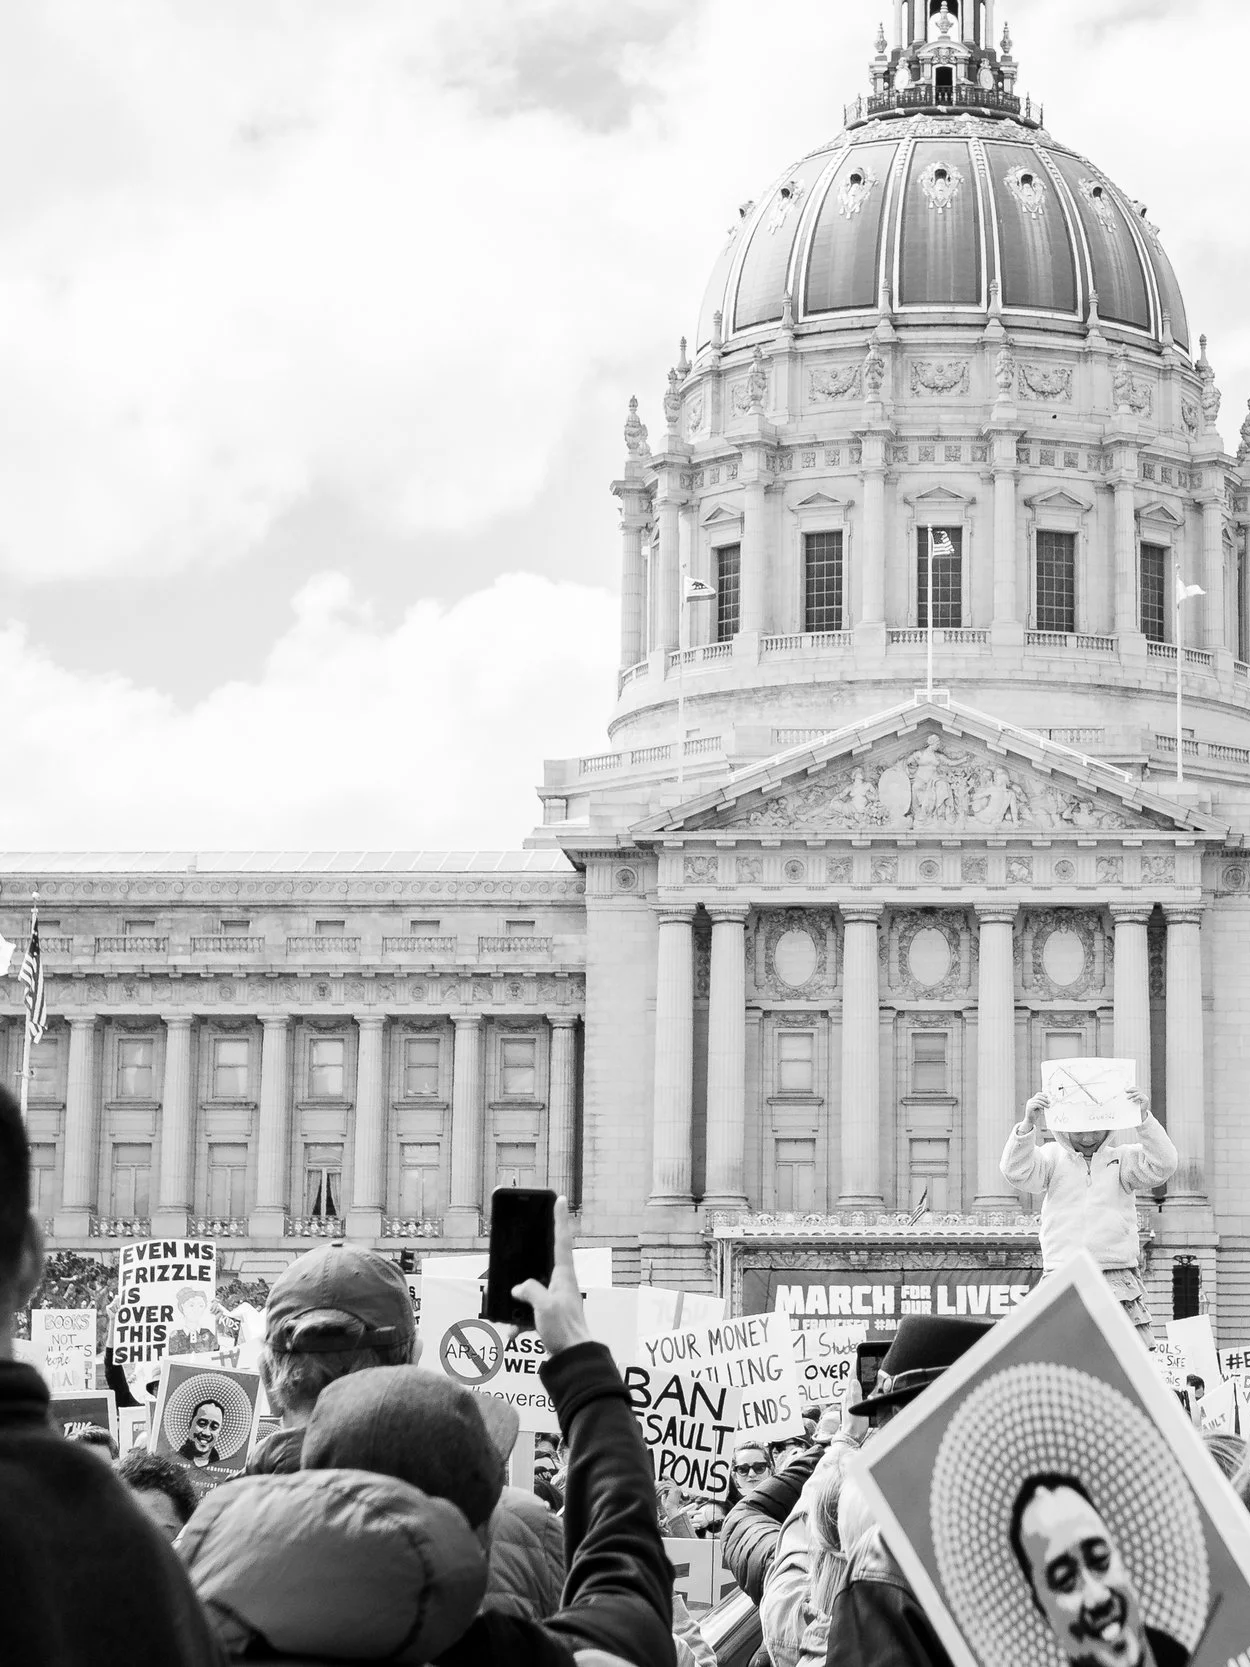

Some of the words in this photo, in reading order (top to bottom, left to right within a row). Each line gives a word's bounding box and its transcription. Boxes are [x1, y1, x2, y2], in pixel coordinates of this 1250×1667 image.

[123, 1241, 177, 1265] EVEN
[122, 1264, 211, 1287] FRIZZLE
[120, 1287, 141, 1306] IS
[775, 1284, 895, 1315] MARCH
[900, 1285, 931, 1300] FOR
[937, 1284, 1031, 1315] LIVES
[117, 1305, 174, 1324] OVER
[900, 1300, 932, 1315] OUR
[44, 1314, 91, 1331] BOOKS
[218, 1316, 240, 1331] KIDS
[51, 1333, 77, 1346] NOT
[116, 1324, 167, 1343] THIS
[645, 1333, 701, 1367] YOUR
[708, 1317, 769, 1356] MONEY
[114, 1343, 166, 1364] SHIT
[445, 1343, 499, 1362] AR-15
[504, 1338, 546, 1355] ASS
[804, 1360, 851, 1380] OVER
[624, 1366, 727, 1421] BAN
[632, 1410, 735, 1455] SAULT
[648, 1447, 730, 1493] PONS
